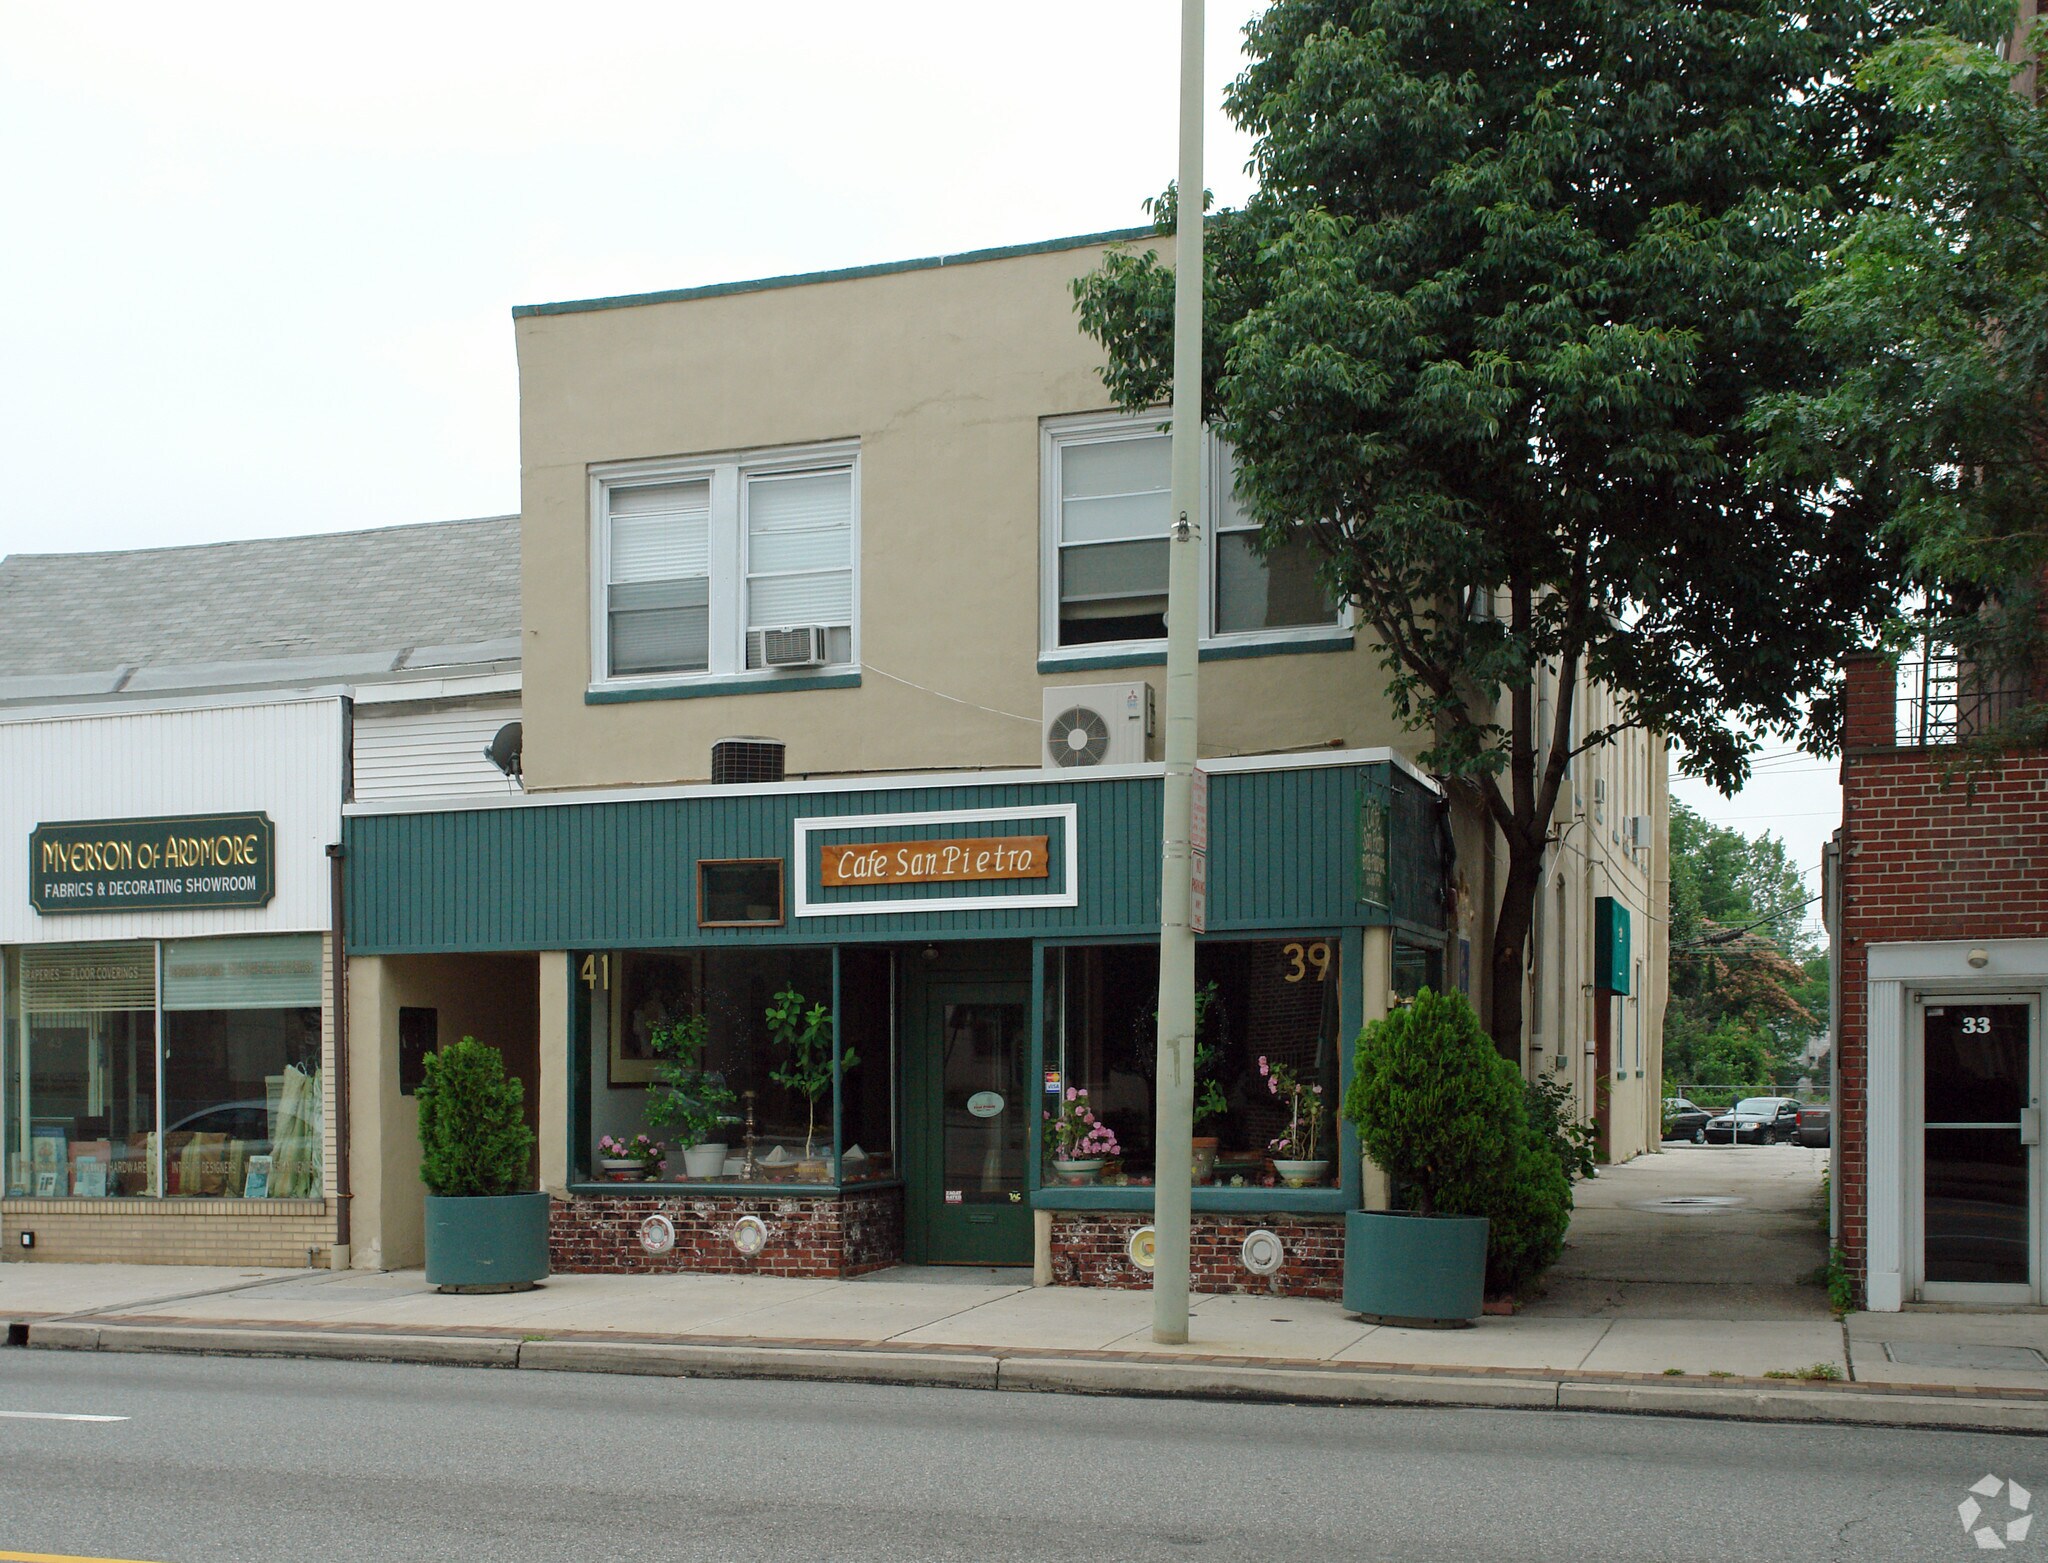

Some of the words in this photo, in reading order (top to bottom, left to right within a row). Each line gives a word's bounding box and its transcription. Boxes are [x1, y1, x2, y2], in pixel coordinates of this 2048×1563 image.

[42, 840, 132, 872] MYERSON
[165, 834, 258, 868] ARDMORE
[837, 850, 888, 879] Cafe
[895, 848, 937, 876] San
[942, 844, 1032, 875] Pietro
[44, 882, 94, 898] FABRICS
[97, 882, 105, 896] &
[108, 878, 182, 896] DECORATING
[186, 876, 256, 893] SHOWROOM
[71, 967, 96, 981] FLOOR
[97, 966, 139, 980] COVERINGS
[581, 954, 609, 990] 41
[1283, 942, 1331, 983] 39
[1961, 1016, 1991, 1034] 33
[109, 1161, 147, 1174] HARDWARE
[201, 1161, 237, 1174] DESIGNERS
